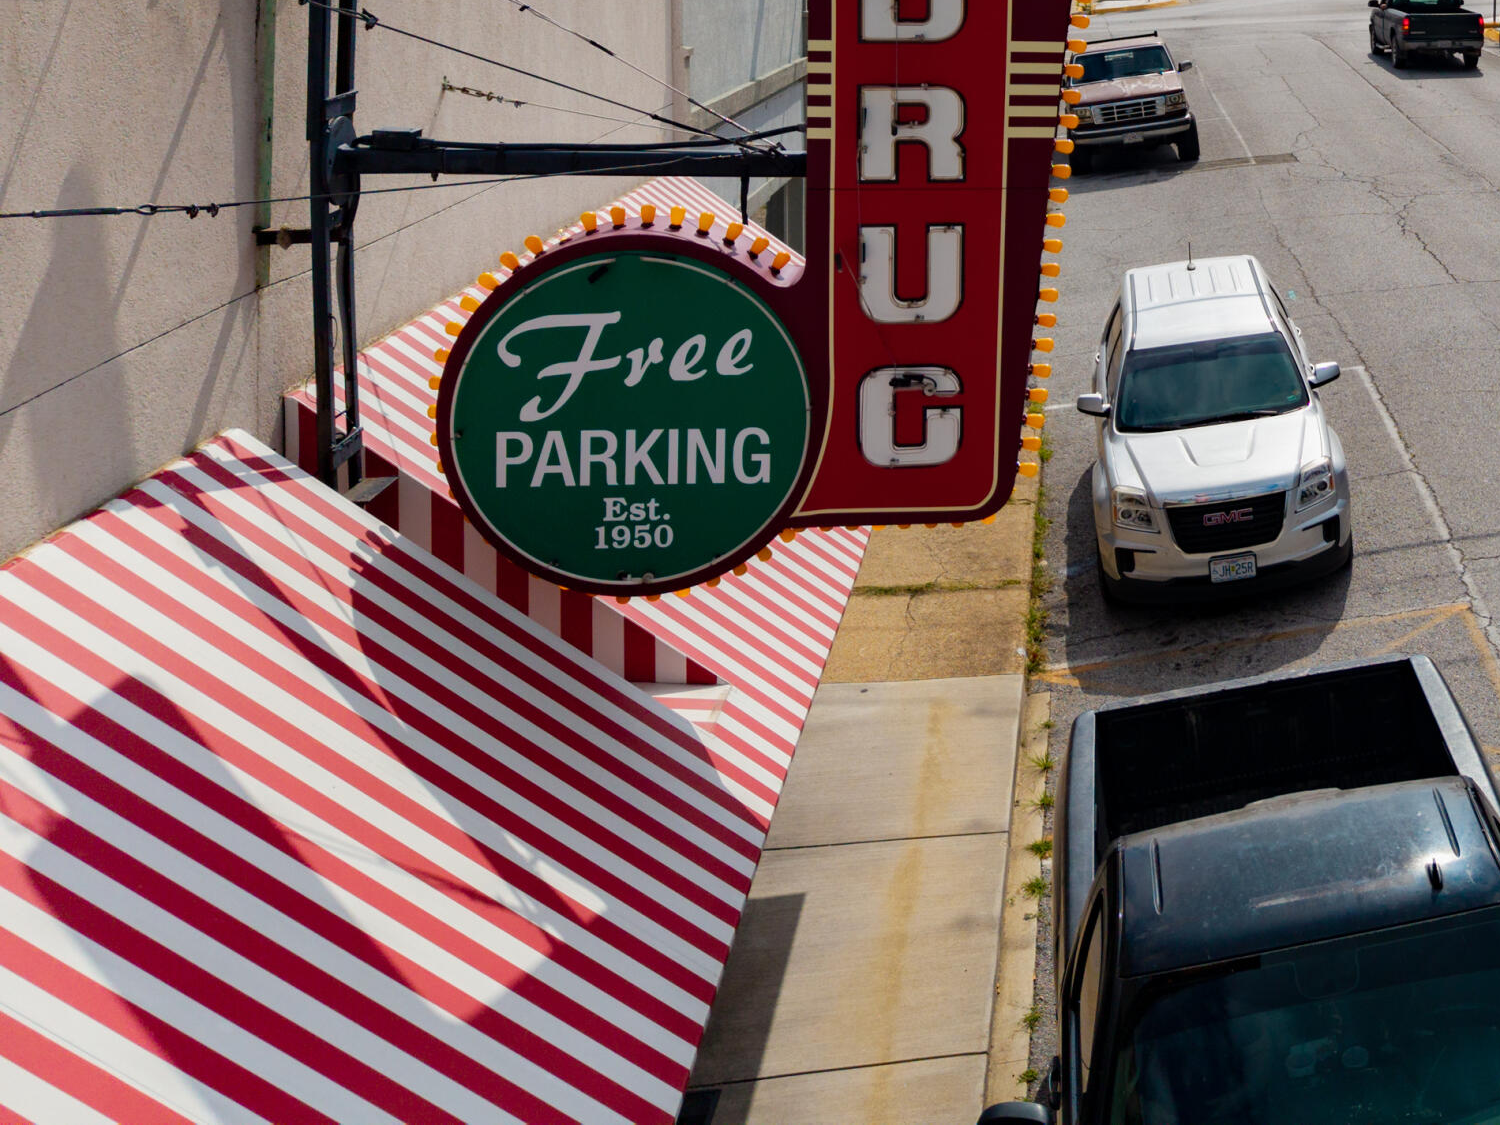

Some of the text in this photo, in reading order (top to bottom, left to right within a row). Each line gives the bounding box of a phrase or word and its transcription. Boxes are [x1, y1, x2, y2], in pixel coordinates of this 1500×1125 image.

[497, 310, 754, 422] Free
[495, 427, 771, 488] PARKING
[602, 497, 671, 522] Est.
[1203, 507, 1254, 526] GMC
[594, 524, 674, 550] 1950
